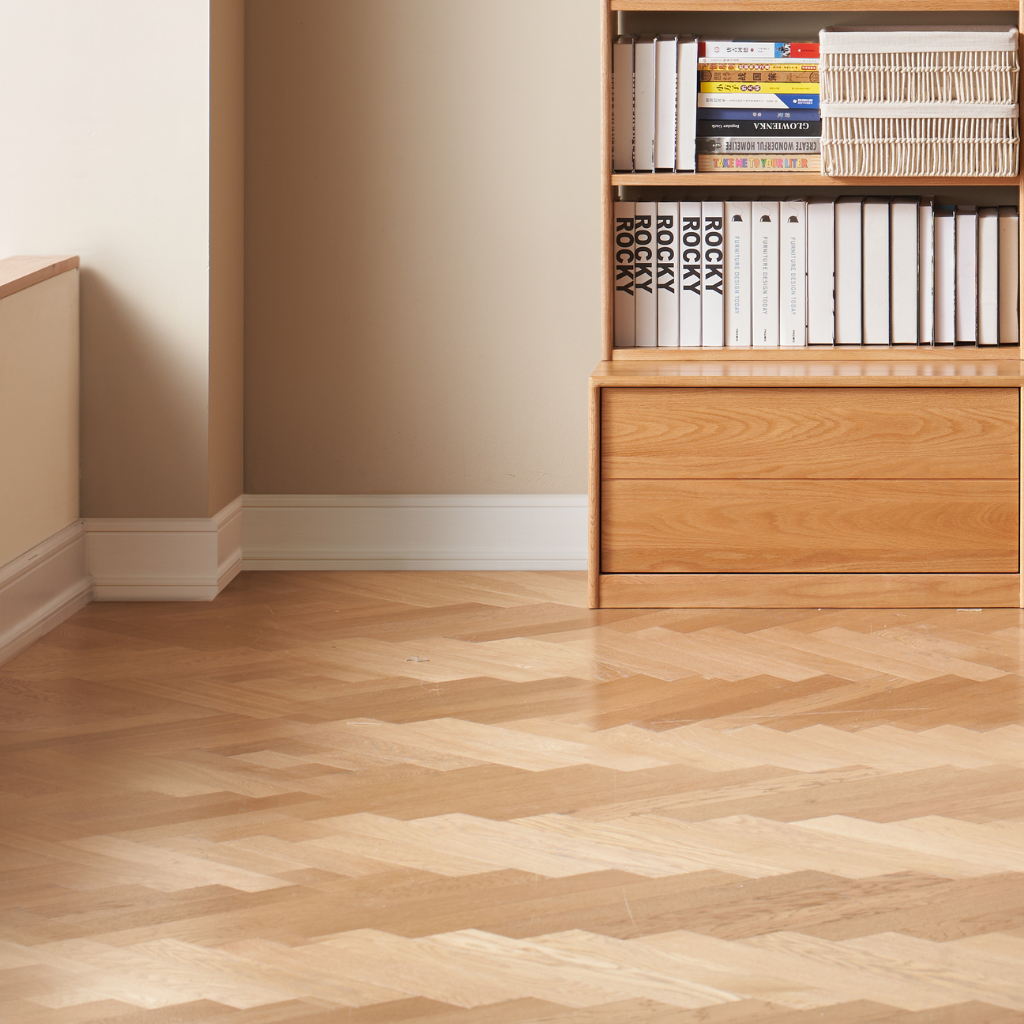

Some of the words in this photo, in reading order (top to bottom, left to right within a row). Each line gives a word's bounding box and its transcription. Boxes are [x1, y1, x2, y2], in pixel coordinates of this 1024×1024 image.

[713, 158, 734, 168] TAKE
[736, 158, 747, 168] ME
[750, 158, 760, 168] TO
[761, 158, 783, 168] YOUR
[785, 158, 808, 168] LITER
[725, 141, 756, 151] HOMELIFE
[757, 141, 794, 151] WONDERFUL
[796, 141, 817, 151] CREATE
[616, 218, 634, 296] ROCKY
[635, 215, 653, 294] ROCKY
[656, 215, 674, 294] ROCKY
[682, 217, 701, 296] ROCKY
[705, 217, 723, 296] ROCKY
